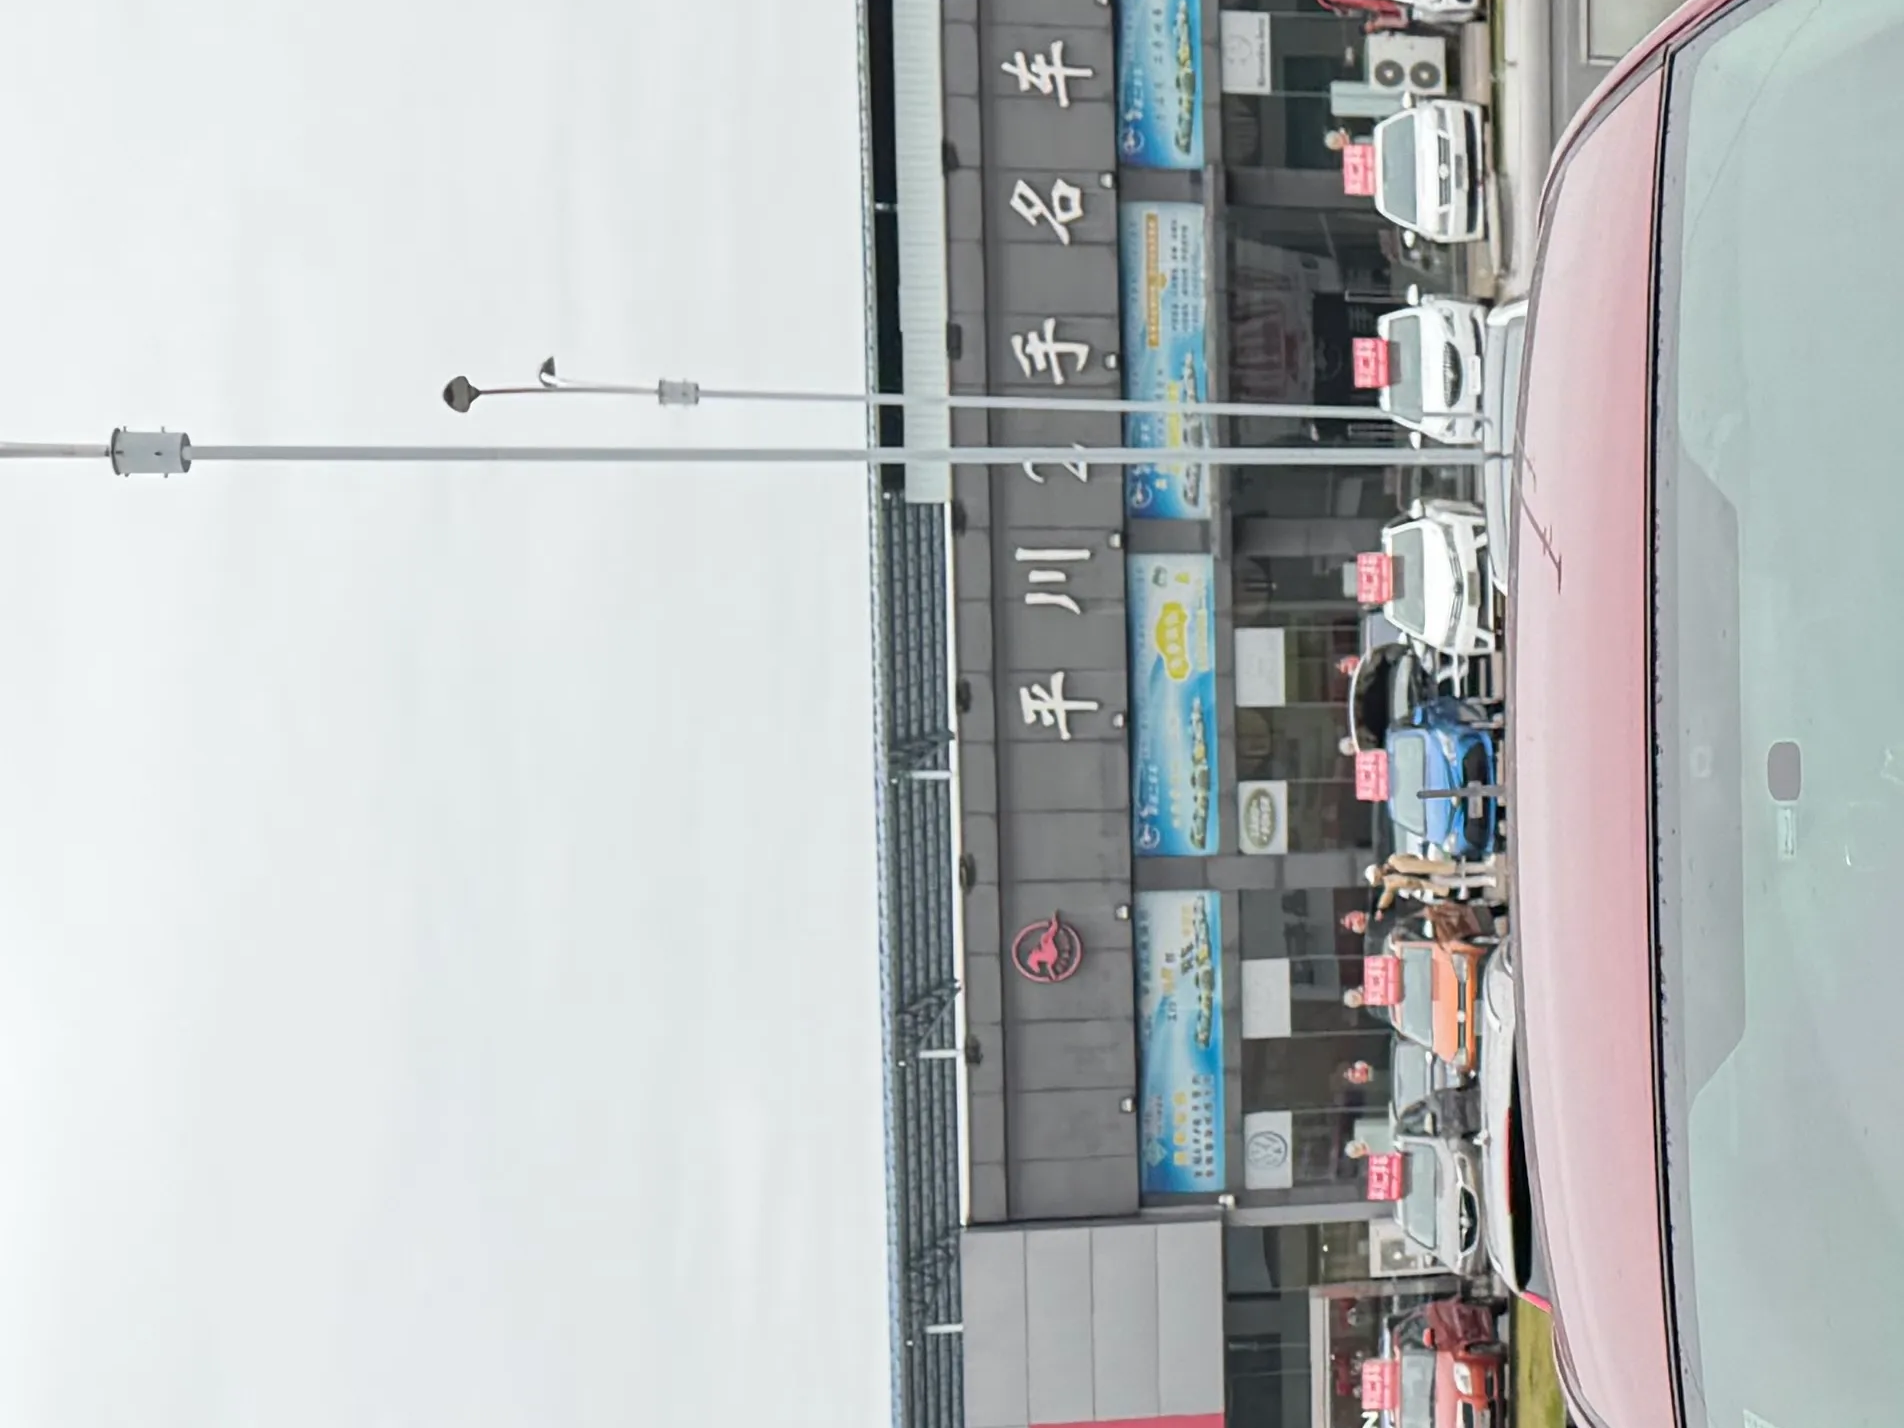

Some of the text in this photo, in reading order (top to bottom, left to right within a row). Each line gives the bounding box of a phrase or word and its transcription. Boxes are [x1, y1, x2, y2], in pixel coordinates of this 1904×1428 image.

[1000, 39, 1099, 741] 平川2手名车
